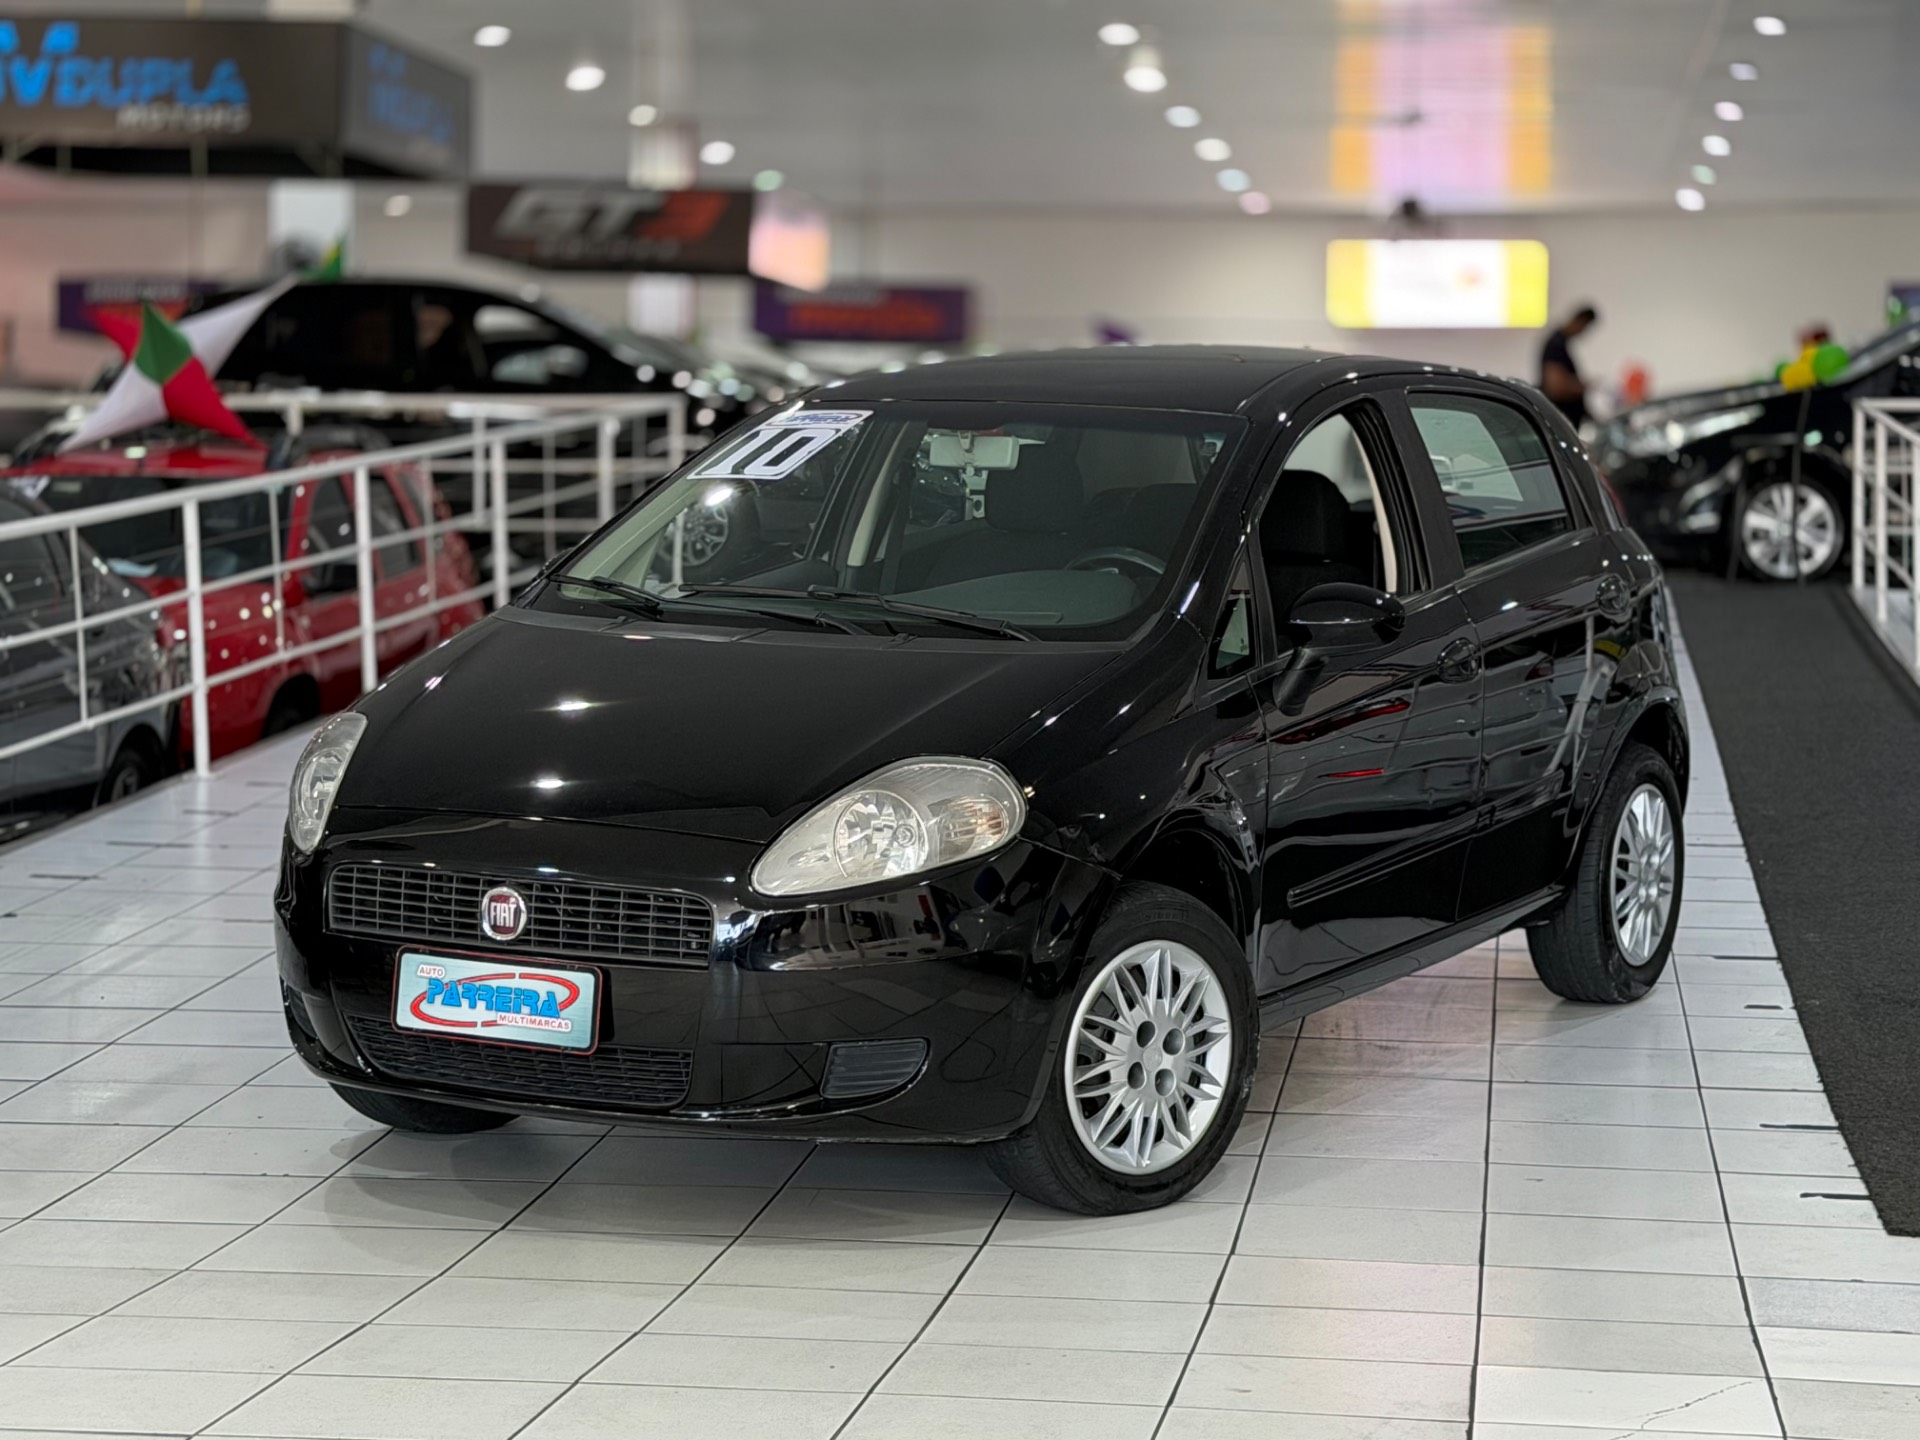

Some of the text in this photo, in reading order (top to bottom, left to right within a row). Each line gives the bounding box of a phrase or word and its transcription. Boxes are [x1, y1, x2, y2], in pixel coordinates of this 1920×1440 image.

[700, 428, 838, 476] 10
[490, 901, 517, 928] FIAT
[418, 966, 444, 976] AUTO
[498, 1014, 570, 1031] MULTIMARCAS
